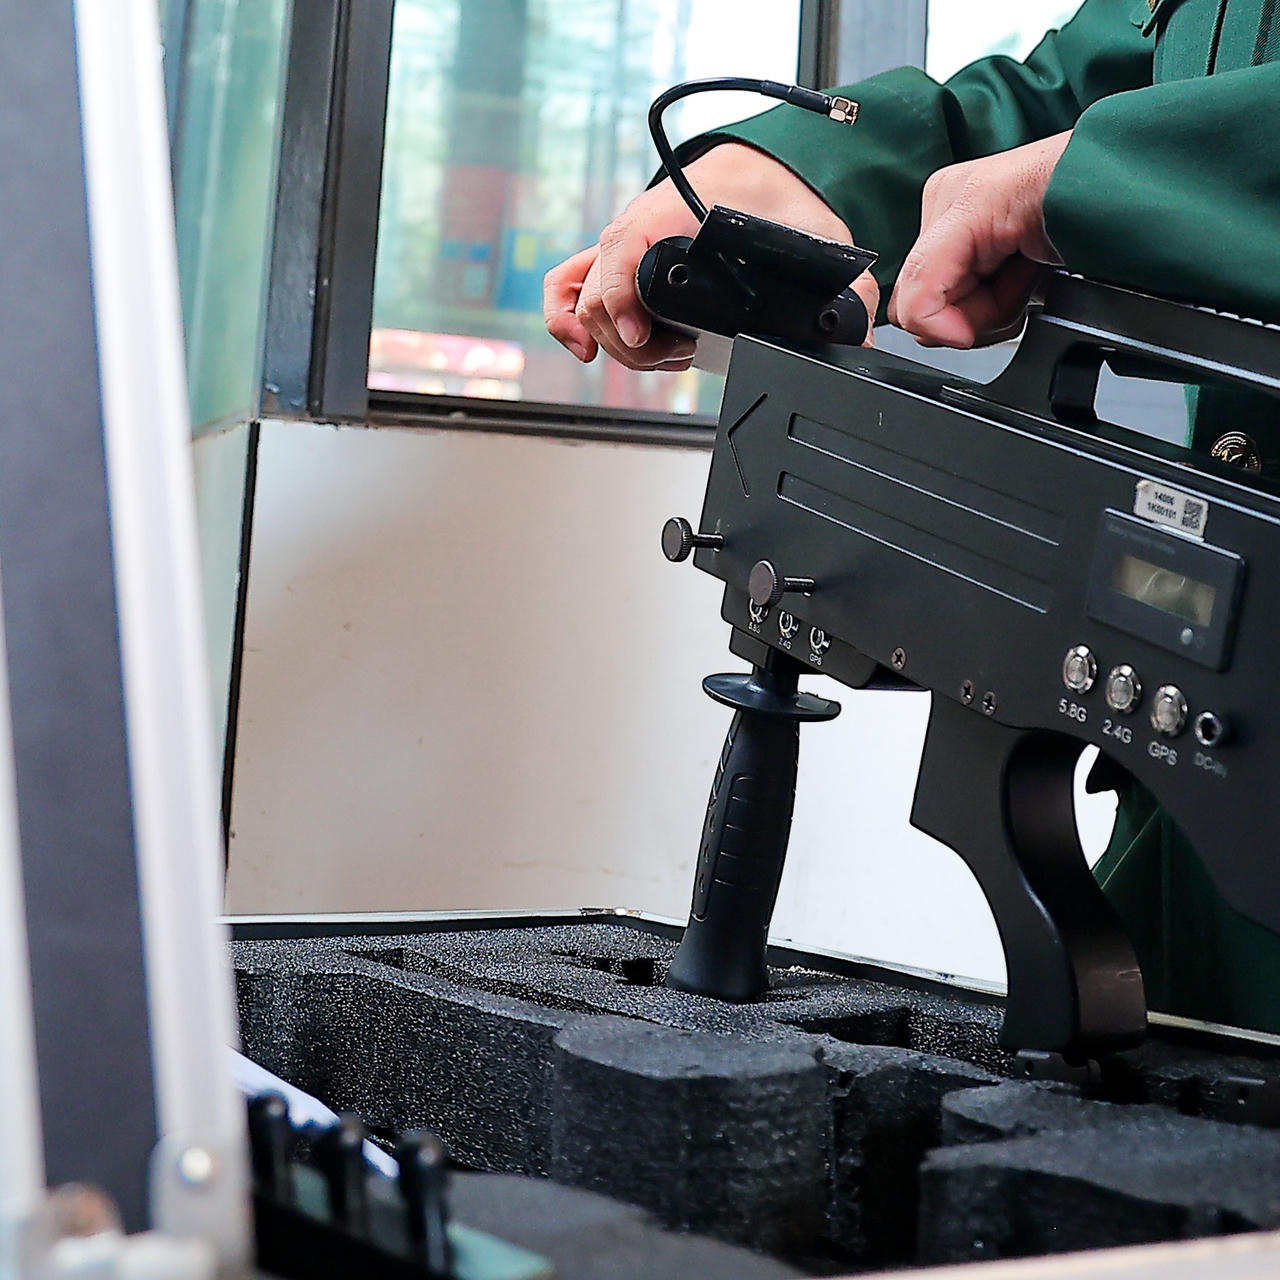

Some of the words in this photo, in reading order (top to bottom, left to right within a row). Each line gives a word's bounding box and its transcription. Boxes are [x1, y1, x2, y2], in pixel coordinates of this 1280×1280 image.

[1058, 698, 1087, 723] 5.8G
[1102, 720, 1133, 744] 2.4G
[1148, 741, 1178, 766] GPS
